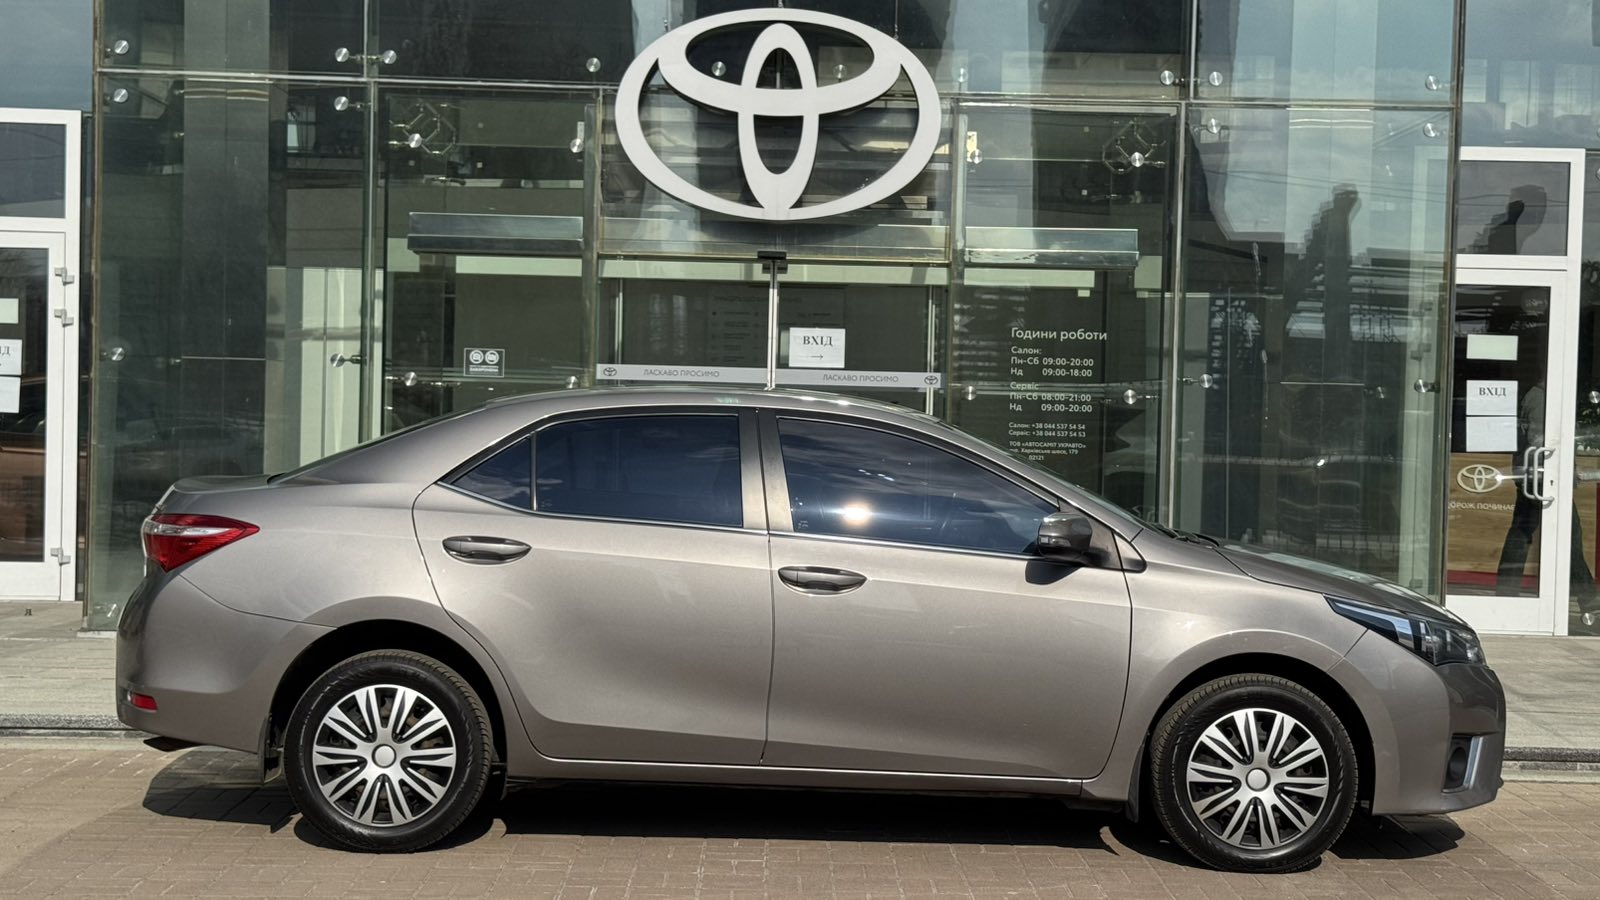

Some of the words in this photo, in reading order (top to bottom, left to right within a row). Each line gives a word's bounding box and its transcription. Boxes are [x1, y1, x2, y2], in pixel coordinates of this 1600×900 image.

[1011, 327, 1057, 340] Години
[1060, 328, 1107, 341] роботи
[803, 335, 833, 347] ВХІД
[1011, 346, 1042, 354] Салон:
[1011, 356, 1039, 365] Пн-Сб
[1042, 357, 1094, 366] 09:00-20:00
[643, 369, 678, 377] ЛАСКАВО
[680, 370, 720, 378] ПРОСИМО
[1010, 367, 1023, 376] Нд
[1042, 368, 1092, 377] 09:00-18:00
[823, 374, 857, 382] ЛАСКАВО
[859, 375, 899, 383] ПРОСИМО
[1009, 392, 1038, 400] Пн-Сб
[1041, 393, 1092, 402] 08:00-21:00
[1479, 387, 1506, 397] ВХІД
[1009, 403, 1022, 411] Нд
[1041, 403, 1093, 412] 09:00-20:00
